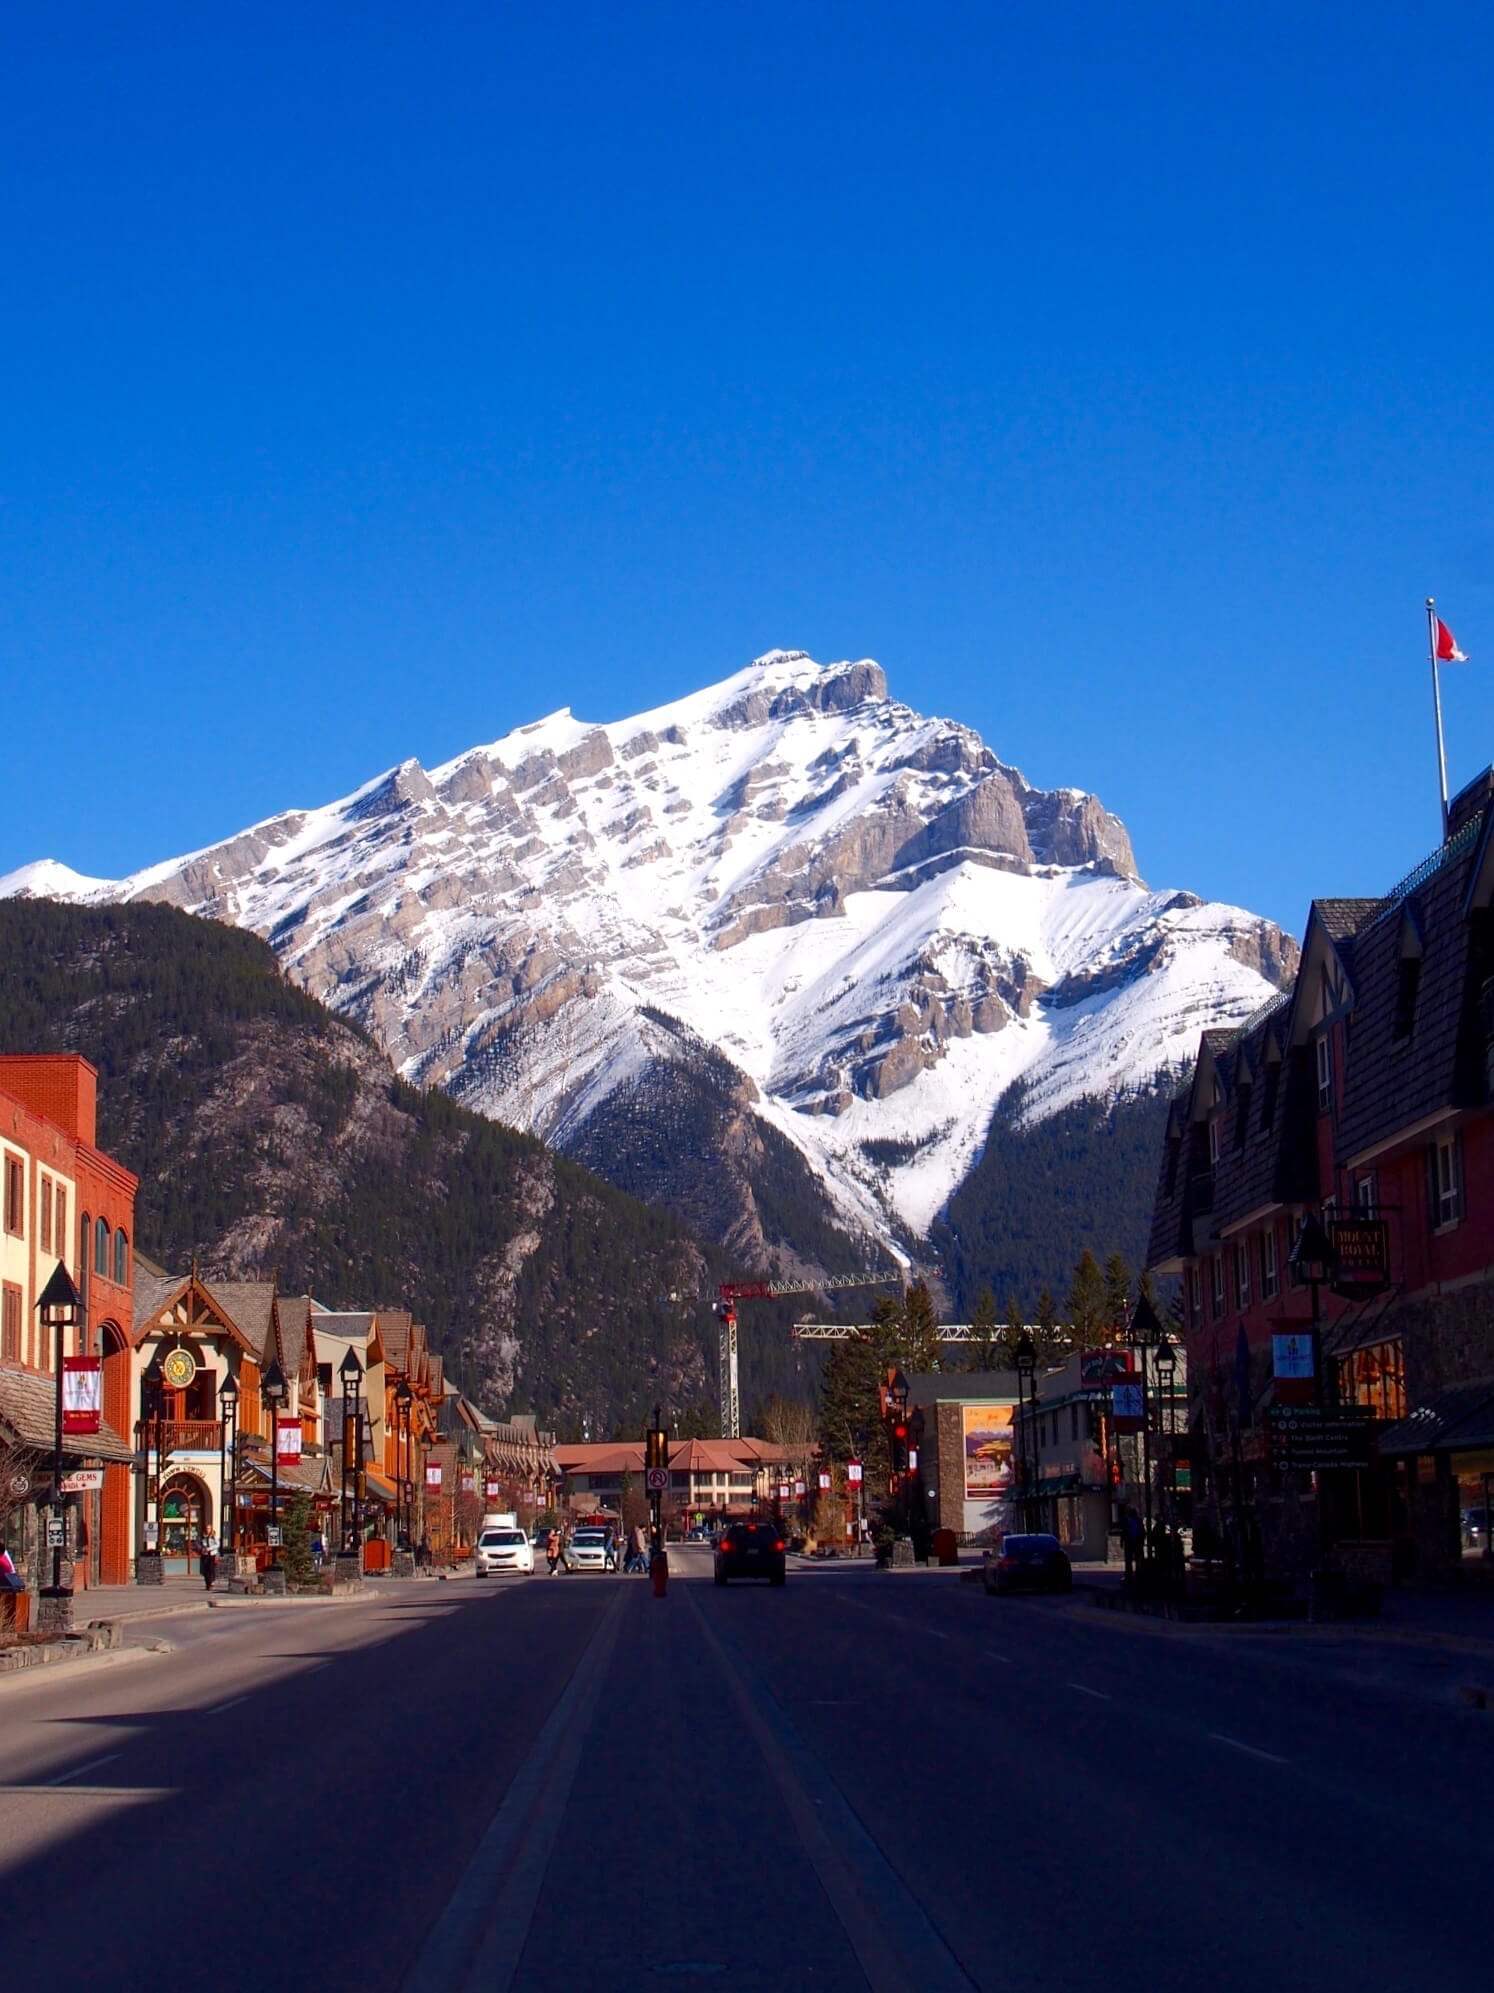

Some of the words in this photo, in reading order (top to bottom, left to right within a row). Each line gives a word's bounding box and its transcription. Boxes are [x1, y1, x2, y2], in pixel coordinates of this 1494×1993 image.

[1337, 1231, 1381, 1243] MOUNT
[1339, 1243, 1381, 1257] ROYAL
[76, 1472, 98, 1482] GEMS
